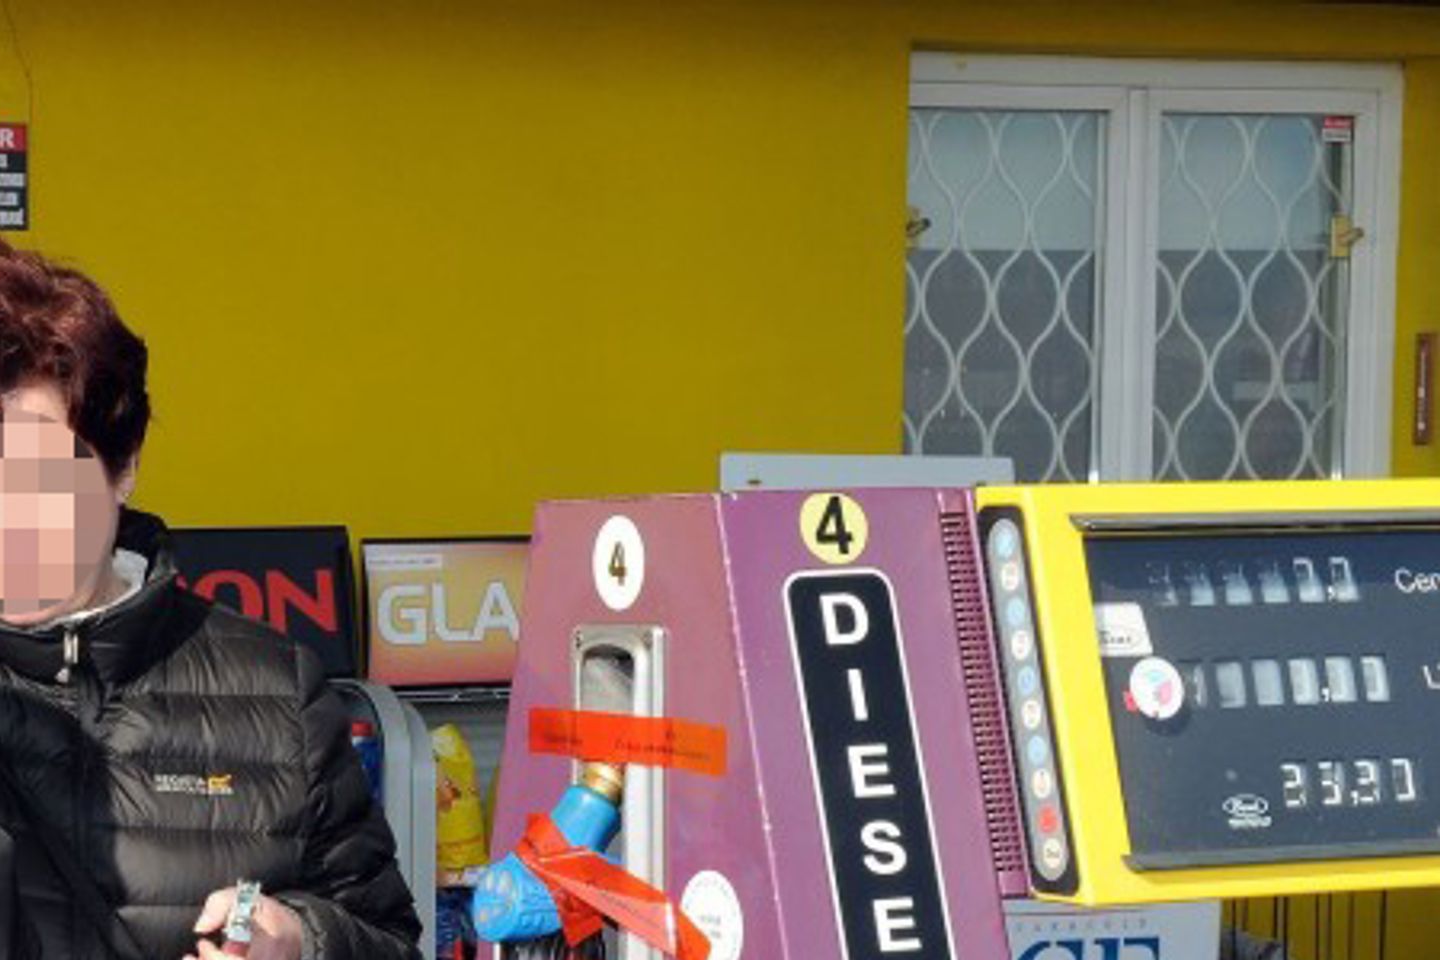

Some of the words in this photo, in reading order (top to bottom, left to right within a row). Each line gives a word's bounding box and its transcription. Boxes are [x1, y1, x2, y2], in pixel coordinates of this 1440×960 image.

[814, 496, 854, 555] 4
[607, 541, 626, 587] 4
[176, 568, 340, 634] ON
